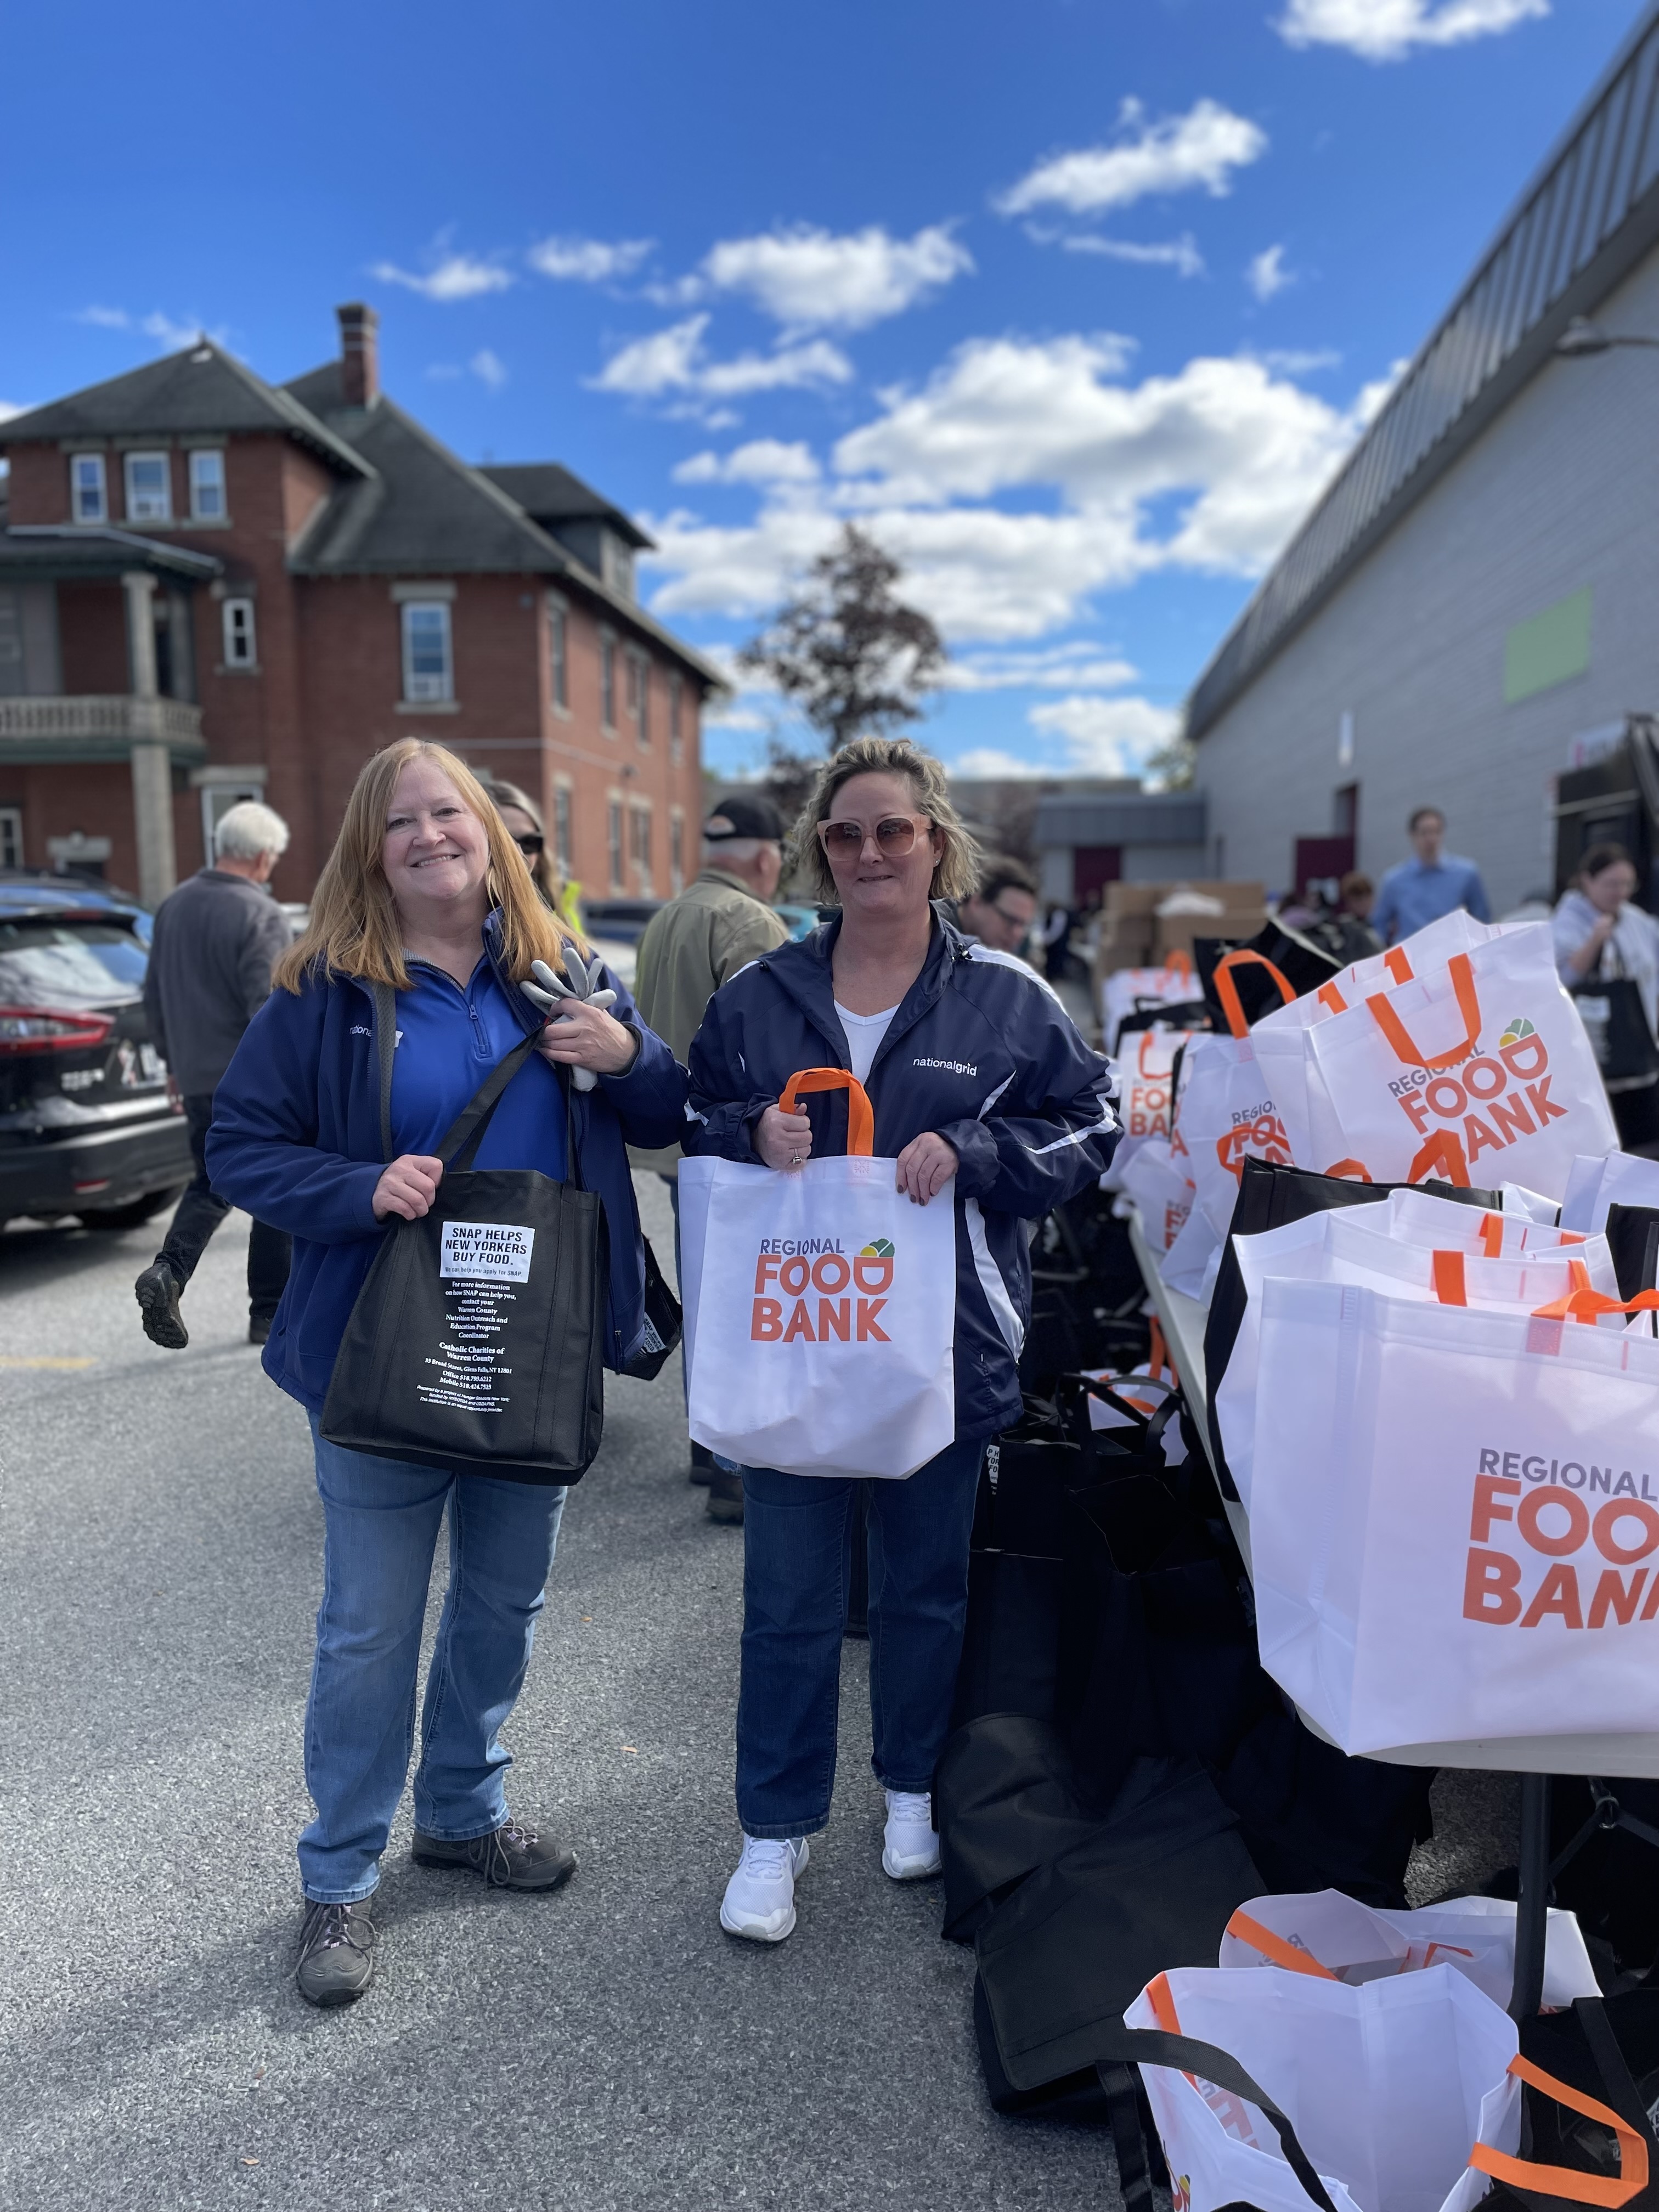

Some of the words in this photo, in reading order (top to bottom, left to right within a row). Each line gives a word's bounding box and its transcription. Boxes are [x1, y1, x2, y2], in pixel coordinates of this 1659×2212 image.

[913, 1057, 977, 1076] nationalgrid
[1398, 1033, 1548, 1135] FOOD
[1132, 1088, 1172, 1111] FO
[1232, 1101, 1276, 1124] REGIO
[1131, 1113, 1170, 1137] BA
[452, 1228, 482, 1239] SNAP
[486, 1230, 522, 1242] HELPS
[445, 1240, 470, 1250] NEW
[475, 1241, 527, 1254] YORKERS
[760, 1238, 845, 1255] REGIONAL
[453, 1251, 476, 1262] BUY
[479, 1253, 514, 1265] FOOD.
[755, 1254, 894, 1296] FOOD
[475, 1282, 510, 1290] information
[476, 1307, 498, 1315] County
[751, 1297, 892, 1342] BANK
[439, 1342, 467, 1353] Catholic
[447, 1351, 471, 1361] Warren
[472, 1355, 494, 1363] County
[439, 1376, 459, 1386] Mobile
[442, 1370, 459, 1379] Office
[1480, 1448, 1658, 1502] REGIONAL
[1470, 1474, 1659, 1565] FOO
[1463, 1547, 1659, 1629] BAN
